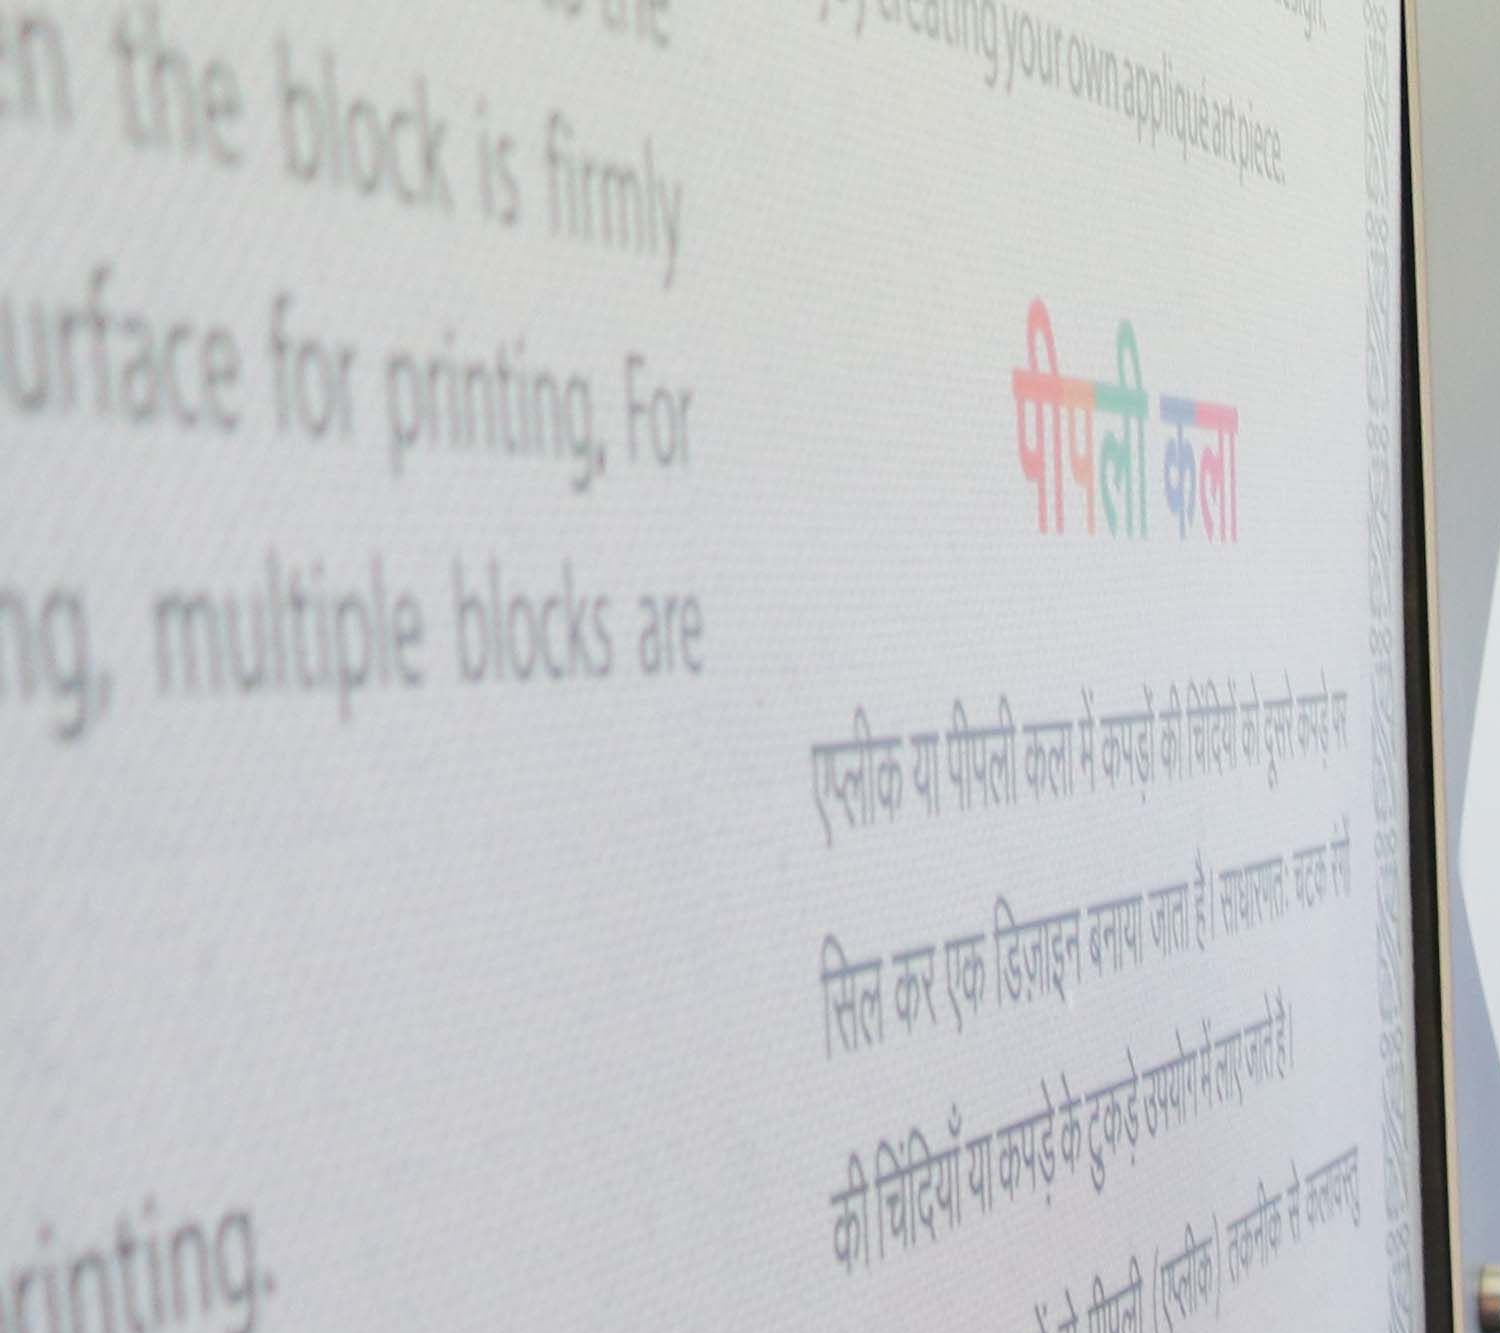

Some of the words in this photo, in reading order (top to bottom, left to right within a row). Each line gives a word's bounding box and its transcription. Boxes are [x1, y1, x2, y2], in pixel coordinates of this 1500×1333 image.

[110, 0, 243, 168] the
[274, 34, 453, 215] block
[475, 94, 518, 227] is
[547, 107, 684, 290] firmly
[1002, 5, 1062, 95] your
[1069, 34, 1120, 111] own
[1212, 94, 1236, 165] art
[269, 292, 357, 438] for
[626, 351, 695, 468] For
[1012, 299, 1149, 537] पीपली
[1160, 394, 1239, 543] कला
[153, 545, 426, 722] multiple
[454, 555, 613, 687] blocks
[638, 592, 706, 676] are
[811, 704, 903, 848] एप्लीक
[909, 733, 940, 816] या
[946, 693, 1017, 811] पीपली
[1022, 721, 1073, 801] कला
[1078, 680, 1095, 793] में
[1159, 680, 1183, 780] की
[821, 932, 883, 1059] सिल
[892, 945, 937, 1035] कर
[944, 933, 986, 1034] एक
[1087, 894, 1144, 976] बनाया
[1147, 882, 1190, 959] जाता
[830, 1152, 869, 1275] की
[965, 1134, 994, 1216] या
[996, 1077, 1057, 1205] कपड़े
[1059, 1072, 1083, 1176] के
[1084, 1045, 1139, 1191] टुकड़े
[1142, 1026, 1199, 1138] उपयोग
[1199, 1017, 1213, 1110] में
[1214, 1031, 1244, 1107] लाए
[1226, 1176, 1283, 1288] तकनीक
[1287, 1159, 1301, 1244] से
